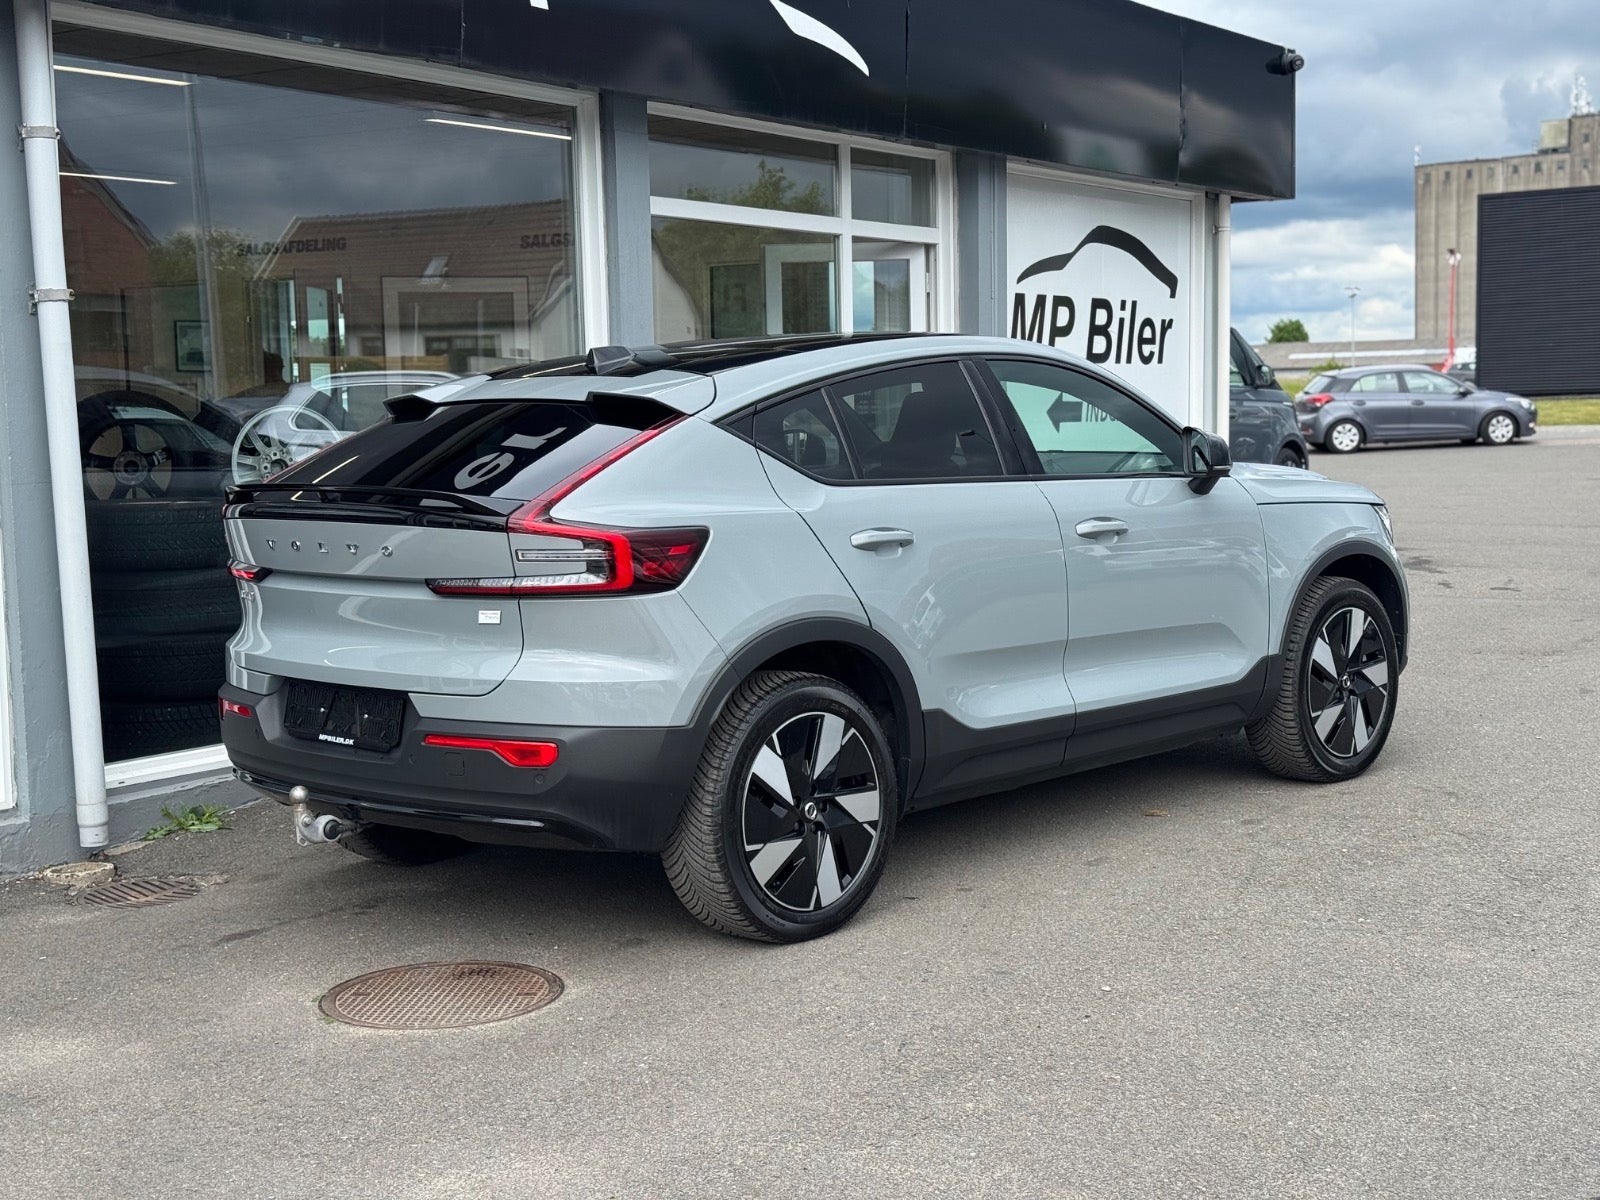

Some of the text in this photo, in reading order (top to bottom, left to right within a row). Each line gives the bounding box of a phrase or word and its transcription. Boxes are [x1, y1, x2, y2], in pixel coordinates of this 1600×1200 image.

[237, 238, 347, 257] SALGSAFDELING
[1011, 293, 1173, 365] MP Biler
[266, 538, 393, 557] VOLVO
